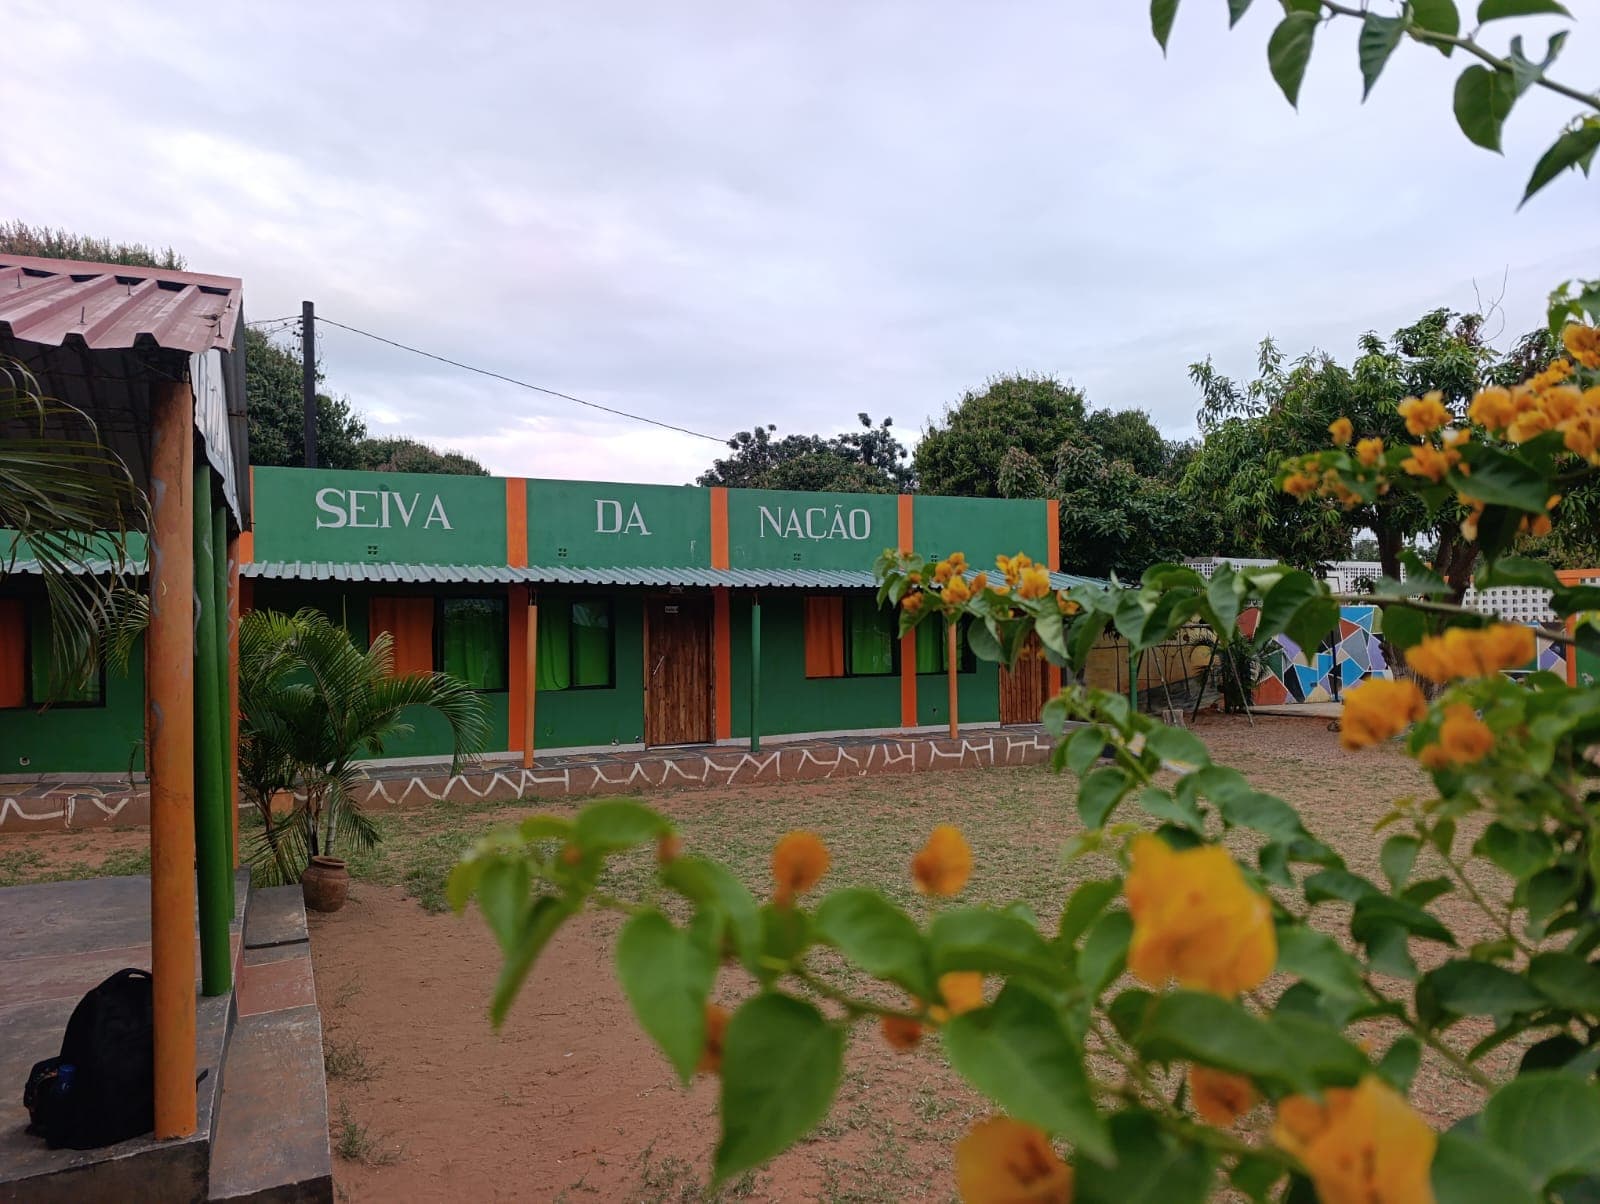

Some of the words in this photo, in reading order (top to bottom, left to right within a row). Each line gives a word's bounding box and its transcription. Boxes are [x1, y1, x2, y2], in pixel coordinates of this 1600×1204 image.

[315, 487, 454, 530] SEIVA
[594, 499, 652, 536] DA
[758, 504, 871, 542] NAÇÃO
